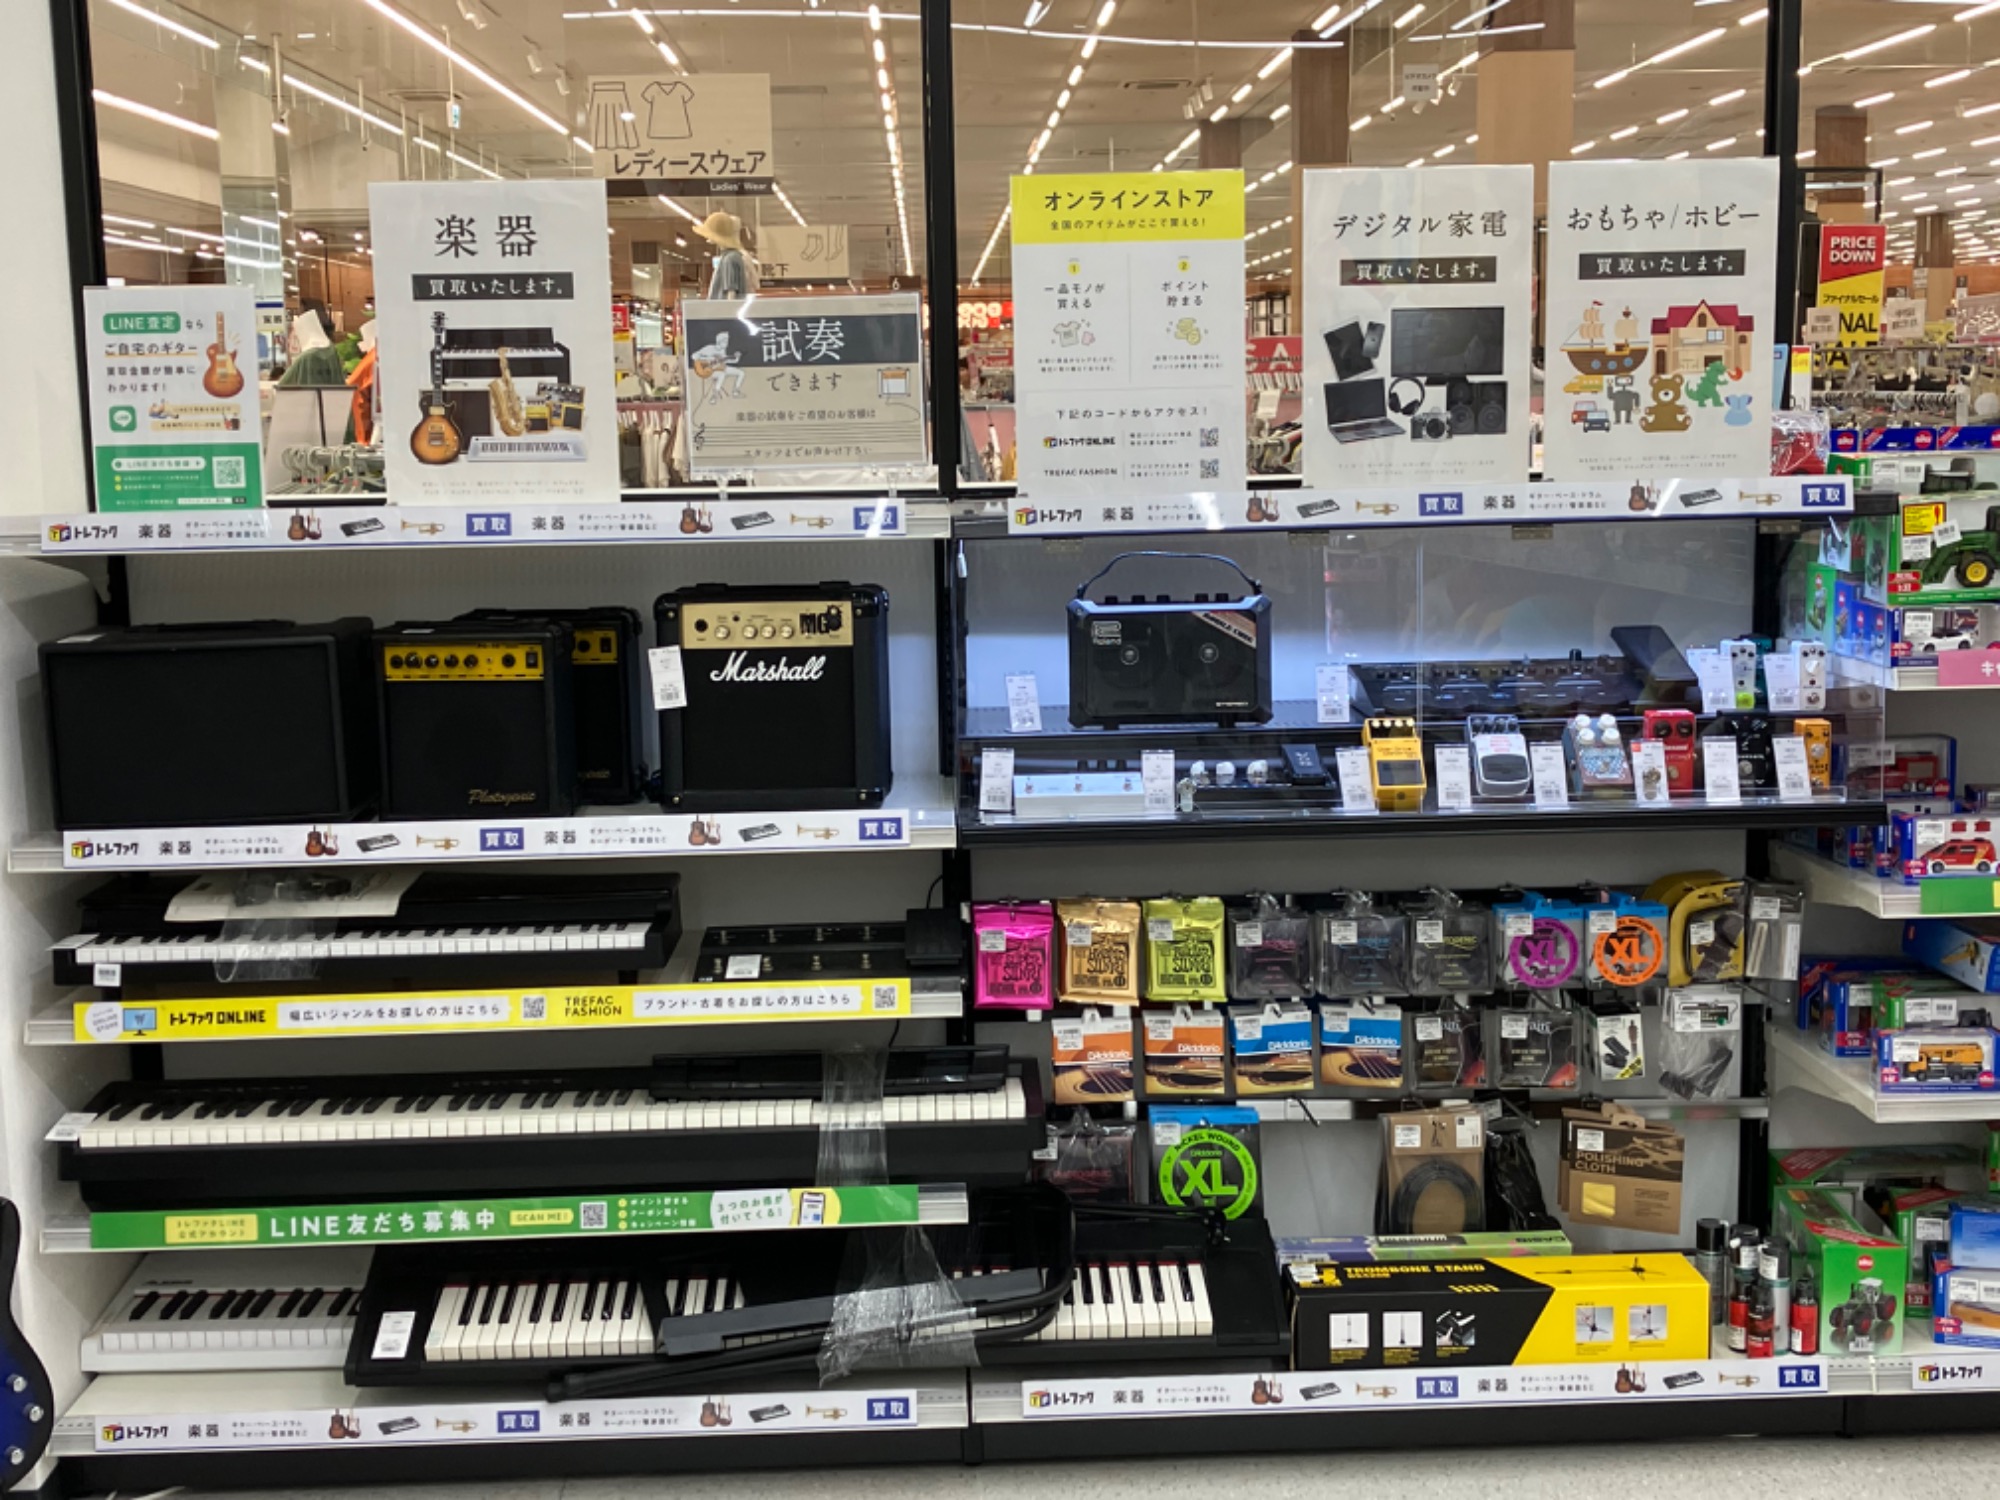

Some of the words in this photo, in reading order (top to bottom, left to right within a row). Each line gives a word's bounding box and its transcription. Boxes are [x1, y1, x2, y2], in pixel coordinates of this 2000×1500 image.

[614, 148, 766, 176] レディースウェア
[710, 182, 741, 191] Ladies'
[744, 181, 767, 191] Wear
[1045, 189, 1214, 211] オンラインストア
[1567, 202, 1760, 231] おもちゃ/ホビー
[1334, 210, 1508, 240] デジタル家電
[434, 215, 538, 258] 楽器
[1830, 235, 1877, 250] PRICE
[1829, 249, 1876, 263] DOWN
[1357, 262, 1488, 281] 買取いたします。
[1597, 254, 1735, 275] 買取いたします。
[429, 278, 562, 296] 買取いたします。
[1161, 280, 1209, 292] ポイント
[1838, 312, 1878, 334] NAL
[761, 318, 845, 362] 試奏
[766, 372, 842, 392] できます
[1483, 495, 1515, 510] 楽器
[1806, 487, 1841, 503] 買取
[1424, 496, 1459, 513] 買取
[1103, 507, 1134, 521] 楽器
[138, 523, 172, 540] 楽器
[471, 516, 506, 533] 買取
[532, 516, 566, 531] 楽器
[711, 651, 826, 683] Marshall
[544, 829, 576, 845] 楽器
[864, 821, 898, 837] 買取
[485, 831, 519, 848] 買取
[159, 841, 191, 856] 楽器
[1525, 939, 1566, 967] XL
[1609, 937, 1650, 964] XL
[565, 995, 614, 1007] TREFAC
[289, 1002, 501, 1021] 幅広いジャンルをお探しの方はこちら
[565, 1005, 622, 1018] FASHION
[1207, 1133, 1241, 1151] WOUND
[1575, 1160, 1616, 1174] CLOTH
[1576, 1151, 1644, 1168] POLISHING
[1179, 1159, 1239, 1197] XL
[270, 1208, 495, 1238] LINE友だち募集中
[1344, 1264, 1432, 1275] TROMBONE
[1435, 1263, 1486, 1273] STAND
[1784, 1369, 1816, 1384] 買取
[1421, 1380, 1454, 1395] 買取
[1477, 1378, 1509, 1393] 楽器
[1113, 1389, 1144, 1404] 楽器
[872, 1401, 904, 1417] 買取
[502, 1413, 535, 1429] 買取
[559, 1411, 590, 1427] 楽器
[188, 1423, 219, 1438] 楽器
